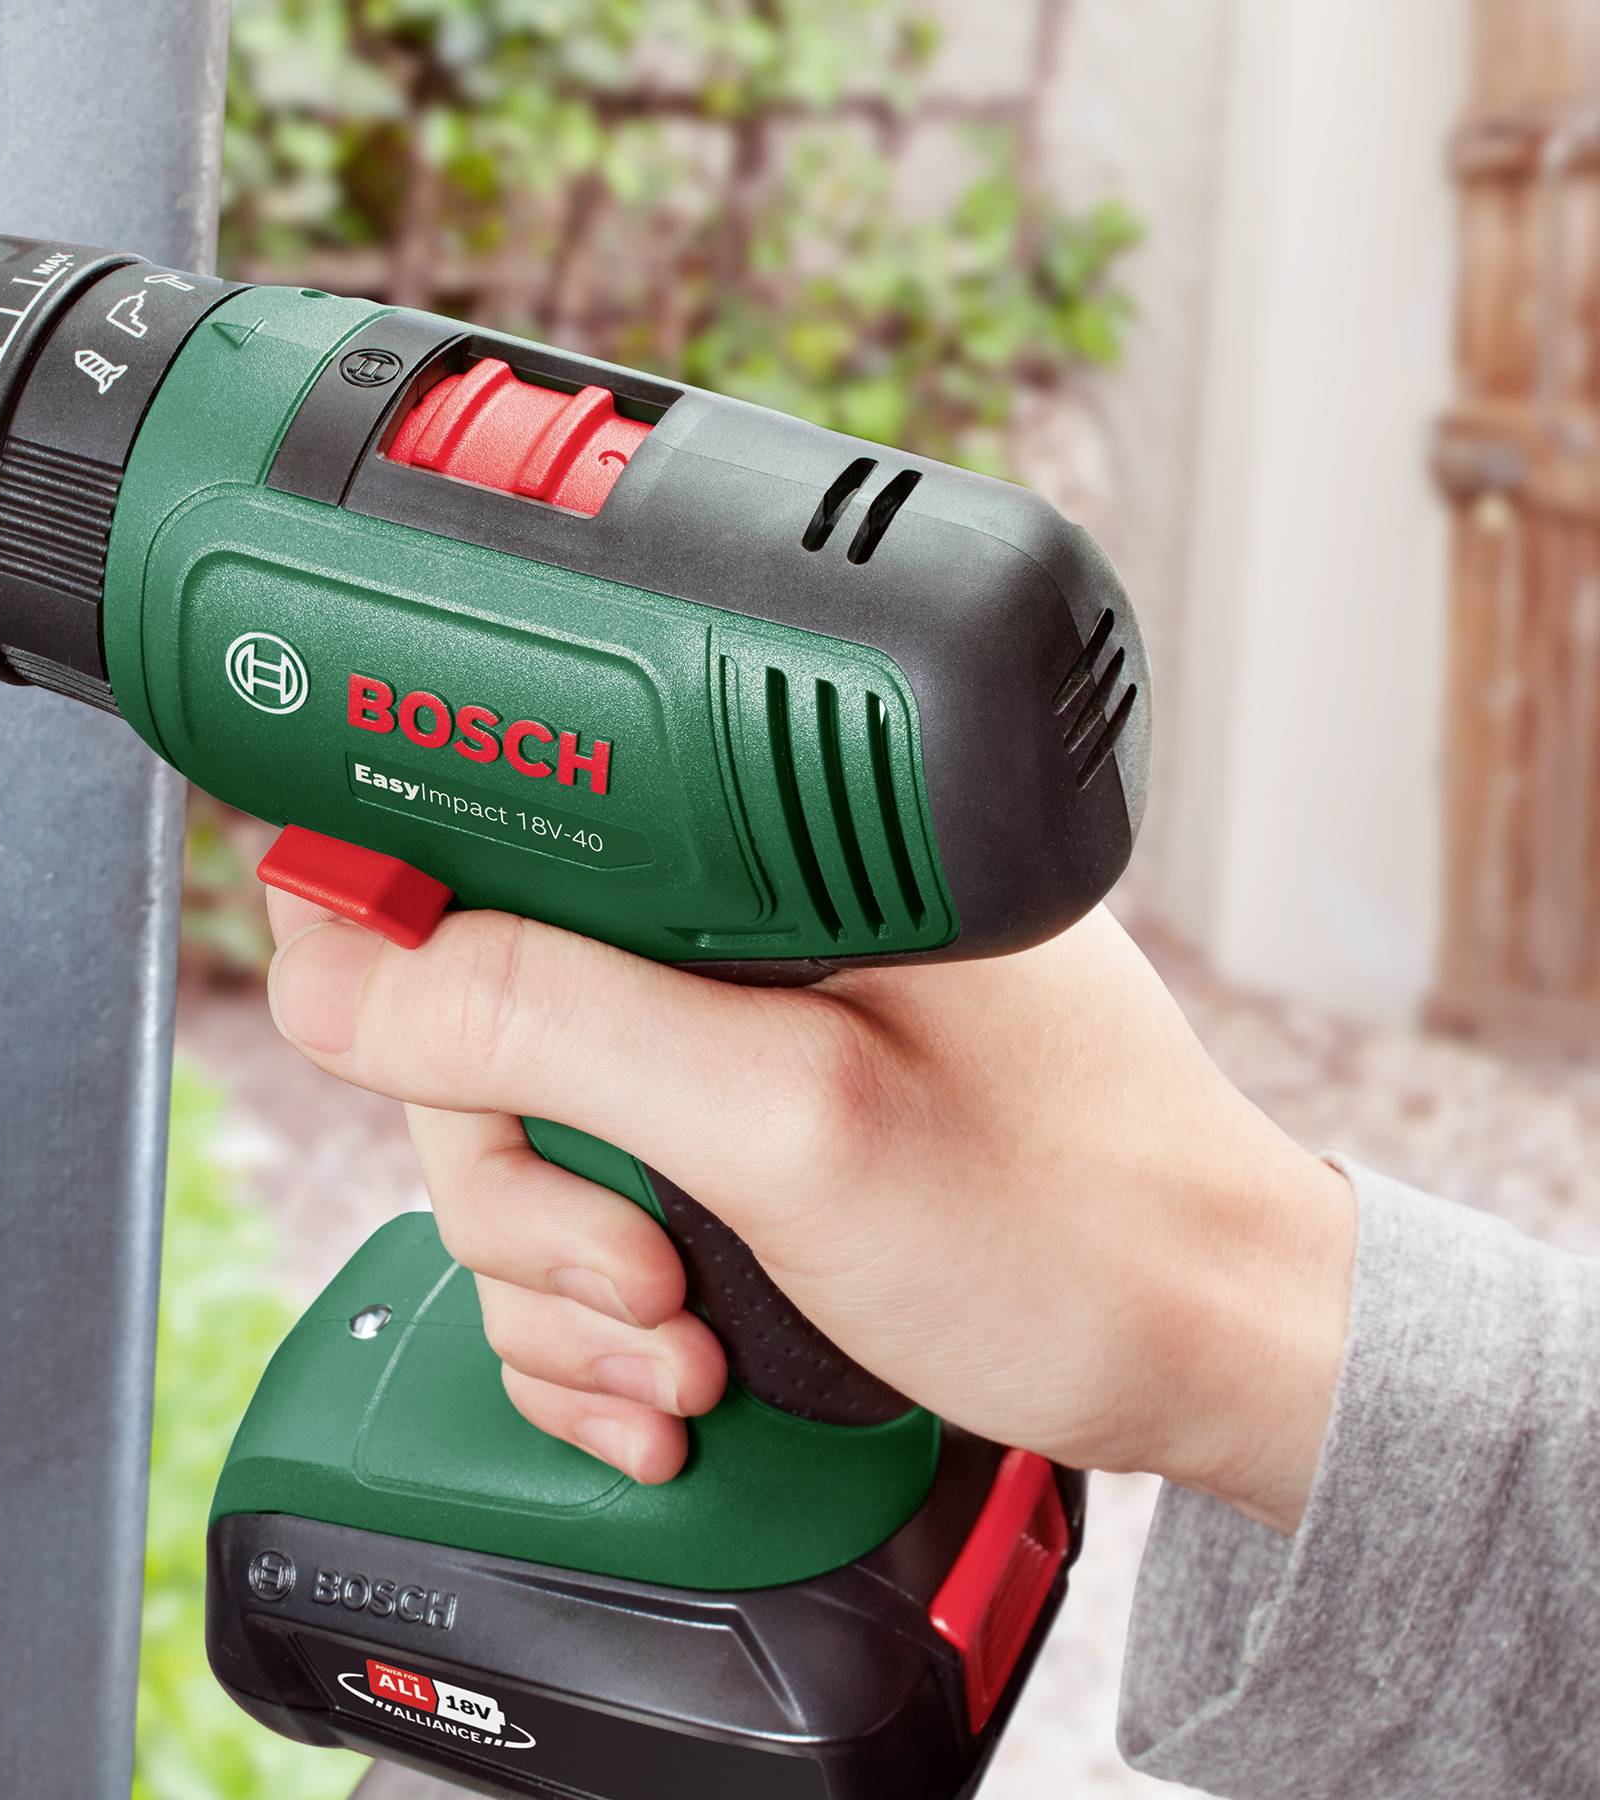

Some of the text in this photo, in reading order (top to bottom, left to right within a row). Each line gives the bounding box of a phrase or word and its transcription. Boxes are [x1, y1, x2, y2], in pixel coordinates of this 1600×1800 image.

[32, 252, 74, 275] MAX
[348, 672, 611, 795] BOSCH
[354, 763, 604, 852] EasyImpact 18V-40
[312, 1566, 457, 1631] BOSCH
[375, 1664, 419, 1682] POWER FOR
[378, 1674, 429, 1702] ALL
[445, 1695, 491, 1720] 18V
[393, 1707, 482, 1744] ALLIANCE
